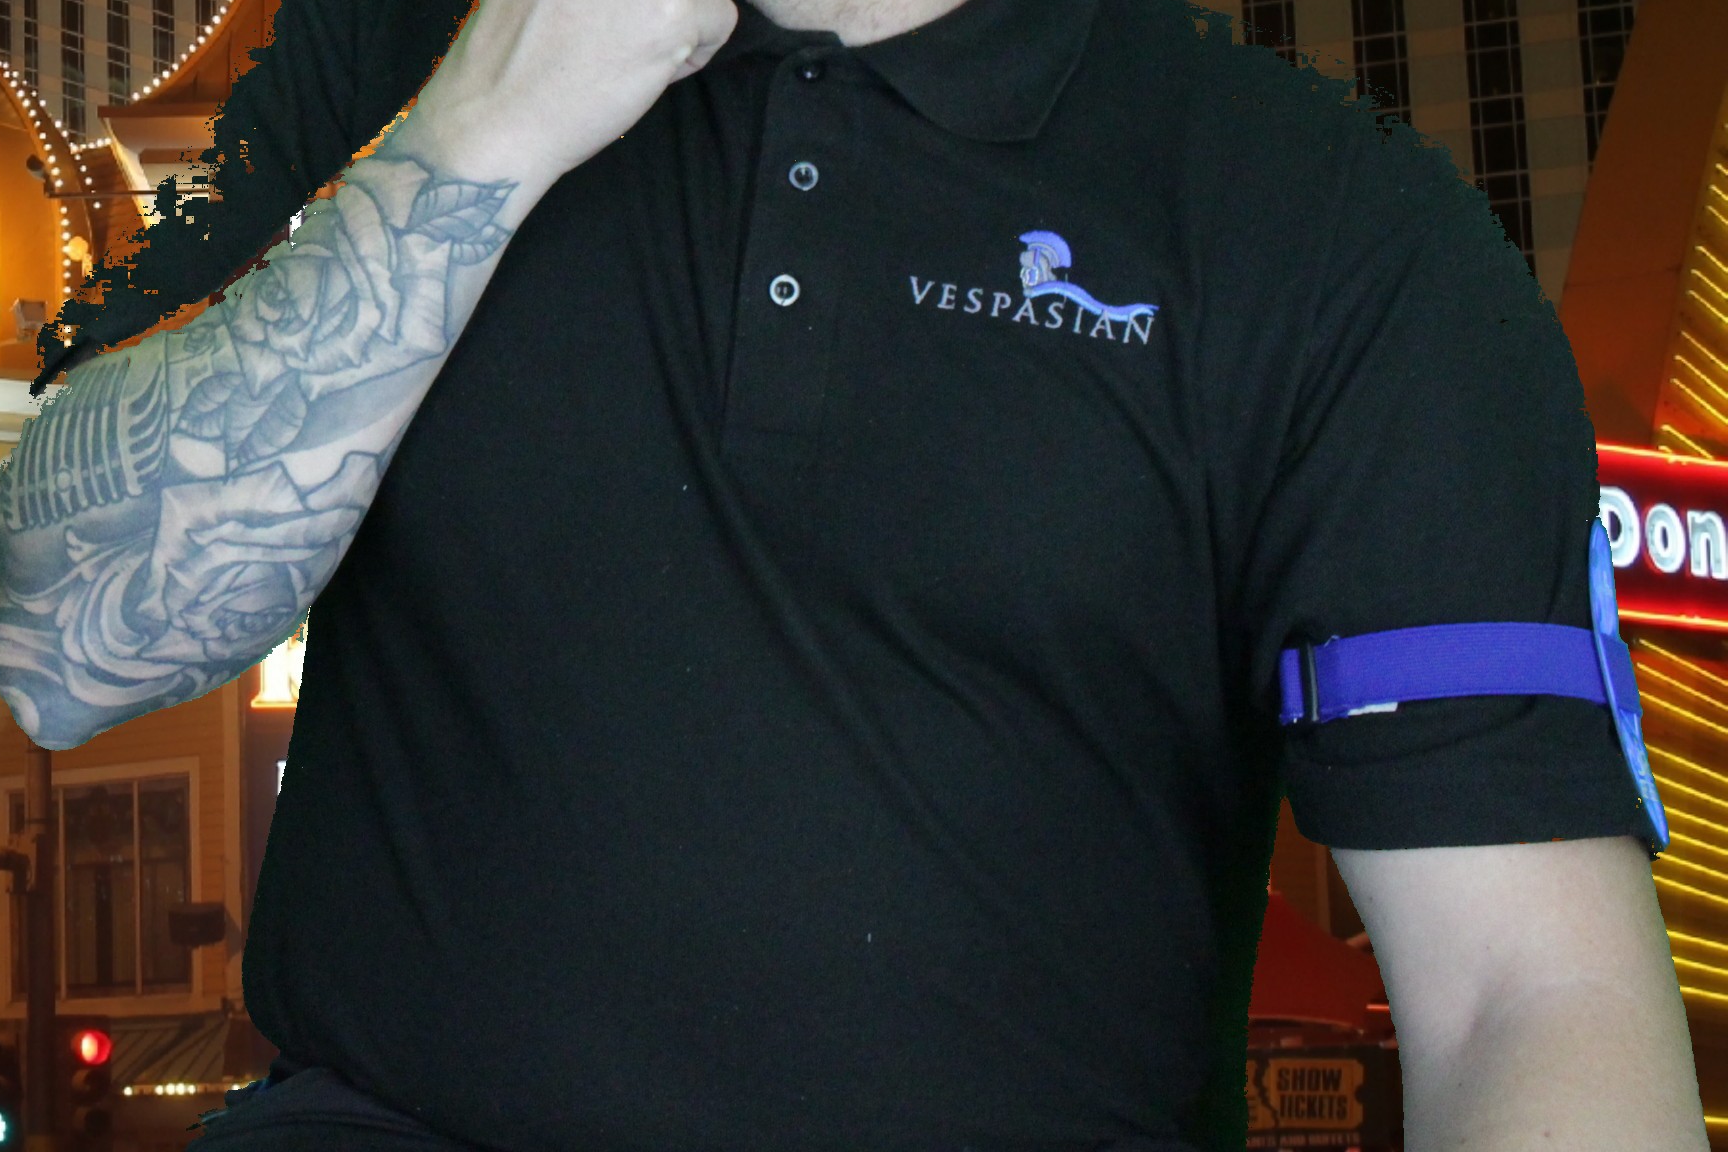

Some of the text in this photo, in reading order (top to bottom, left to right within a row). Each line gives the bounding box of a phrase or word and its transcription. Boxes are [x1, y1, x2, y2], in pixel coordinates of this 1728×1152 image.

[909, 275, 1155, 345] VESPASIAN
[1277, 1067, 1342, 1092] SHOW
[1279, 1094, 1347, 1120] TICKETS
